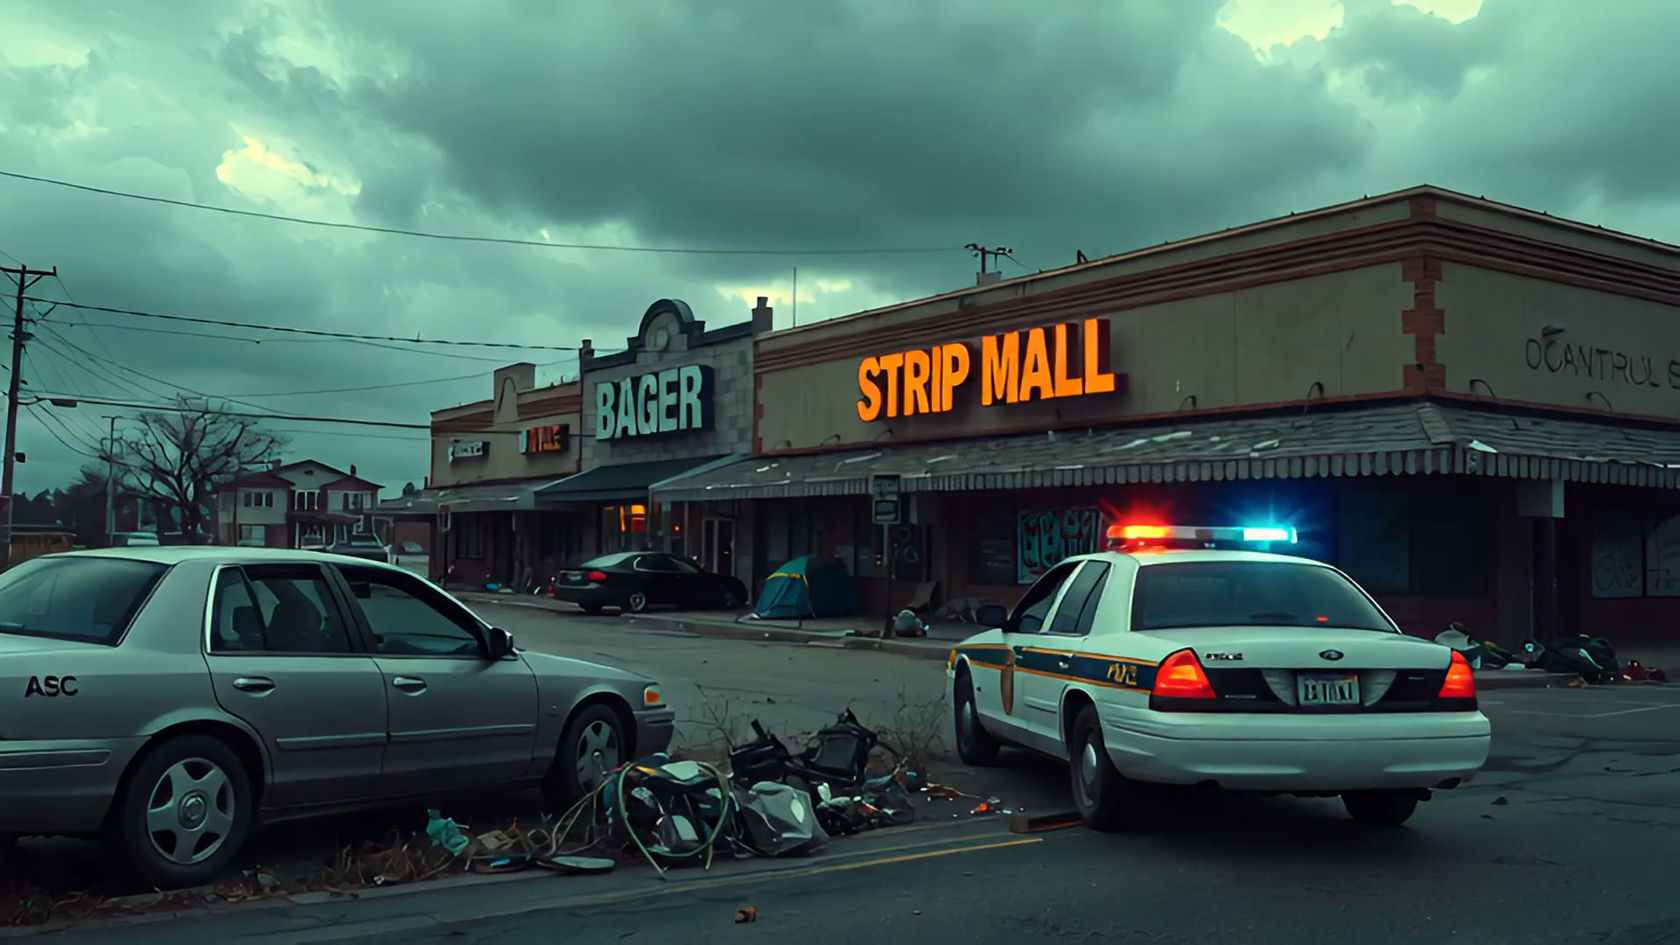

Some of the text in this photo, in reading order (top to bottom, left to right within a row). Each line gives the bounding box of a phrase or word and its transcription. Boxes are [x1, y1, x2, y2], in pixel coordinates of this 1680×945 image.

[595, 364, 703, 440] BAGER
[857, 317, 1115, 422] STRIP MALL
[24, 675, 79, 698] ASC
